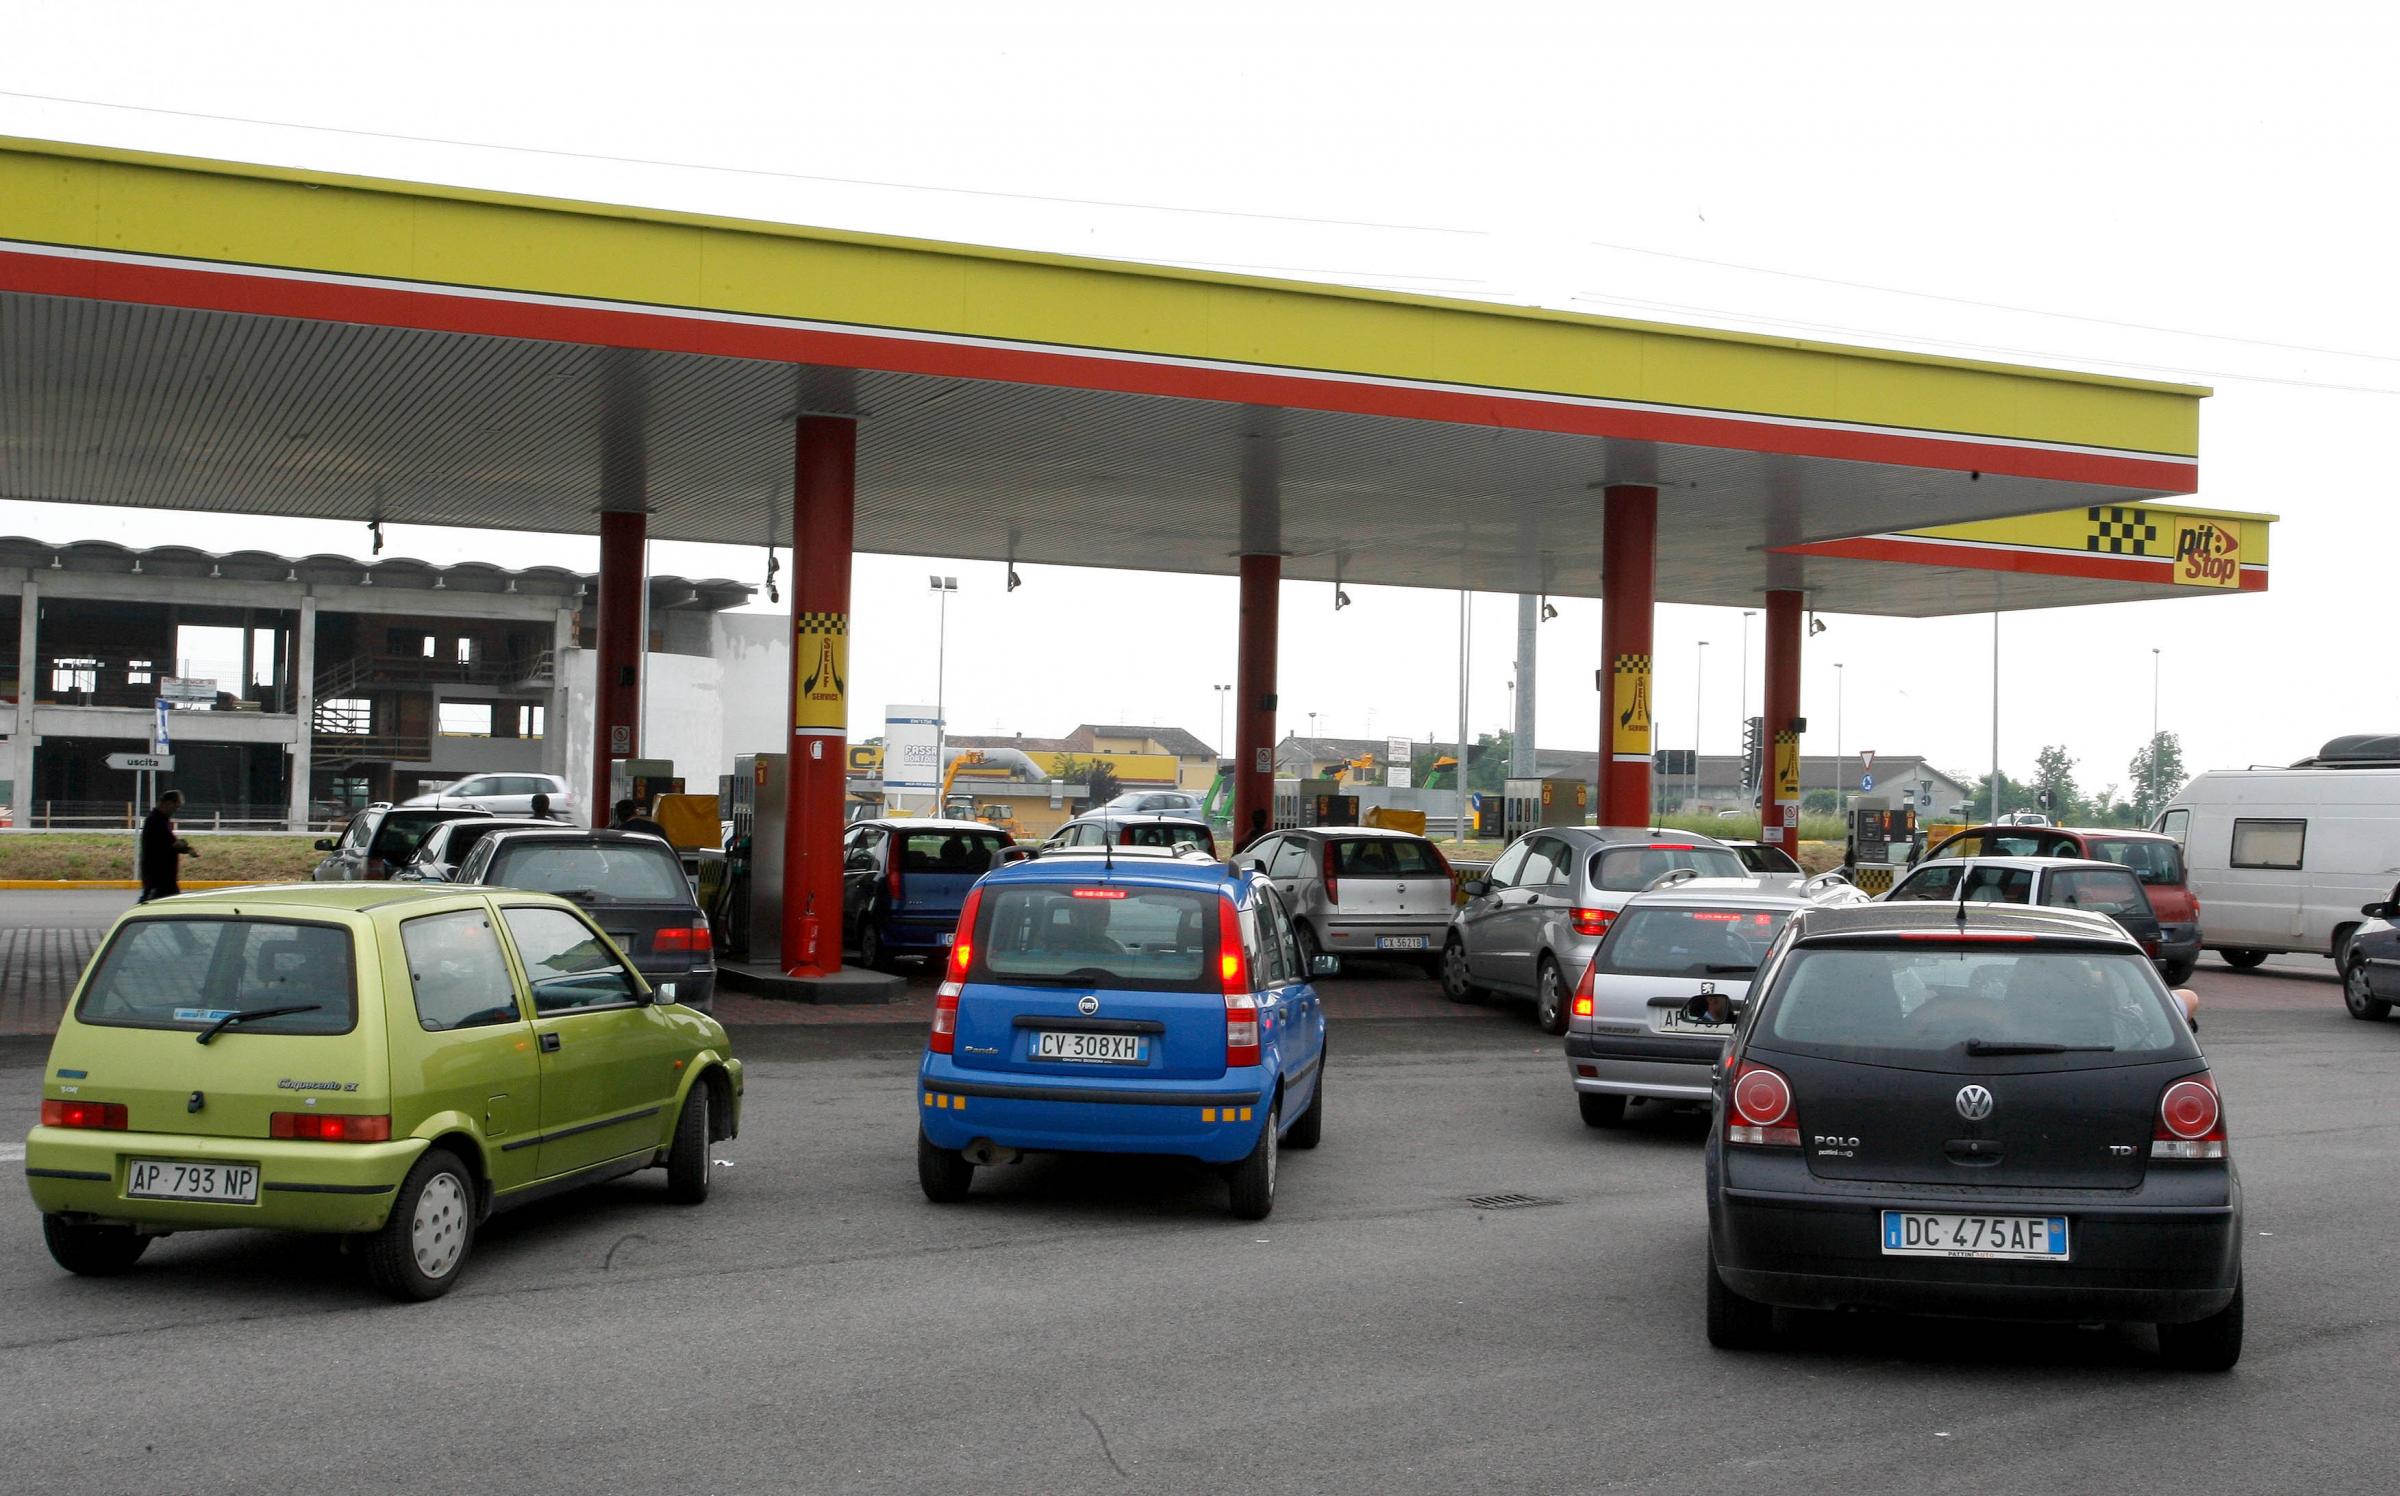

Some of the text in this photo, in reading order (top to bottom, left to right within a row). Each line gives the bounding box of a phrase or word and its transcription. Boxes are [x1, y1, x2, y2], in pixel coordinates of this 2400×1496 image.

[2176, 525, 2214, 562] pit
[2185, 549, 2236, 585] Stop
[823, 637, 832, 688] SELF
[812, 693, 840, 701] SERVICE
[127, 758, 159, 767] uscita
[757, 767, 765, 783] 1
[1543, 791, 1551, 804] 9
[1082, 1002, 1095, 1010] FIAT
[1042, 1034, 1066, 1055] CV
[1073, 1035, 1136, 1058] 308XH
[278, 1079, 341, 1092] Cinquecento
[1814, 1135, 1860, 1146] POLO
[133, 1164, 253, 1196] AP 793 NP
[1905, 1216, 1940, 1246] DC
[1952, 1218, 2044, 1249] 475AF
